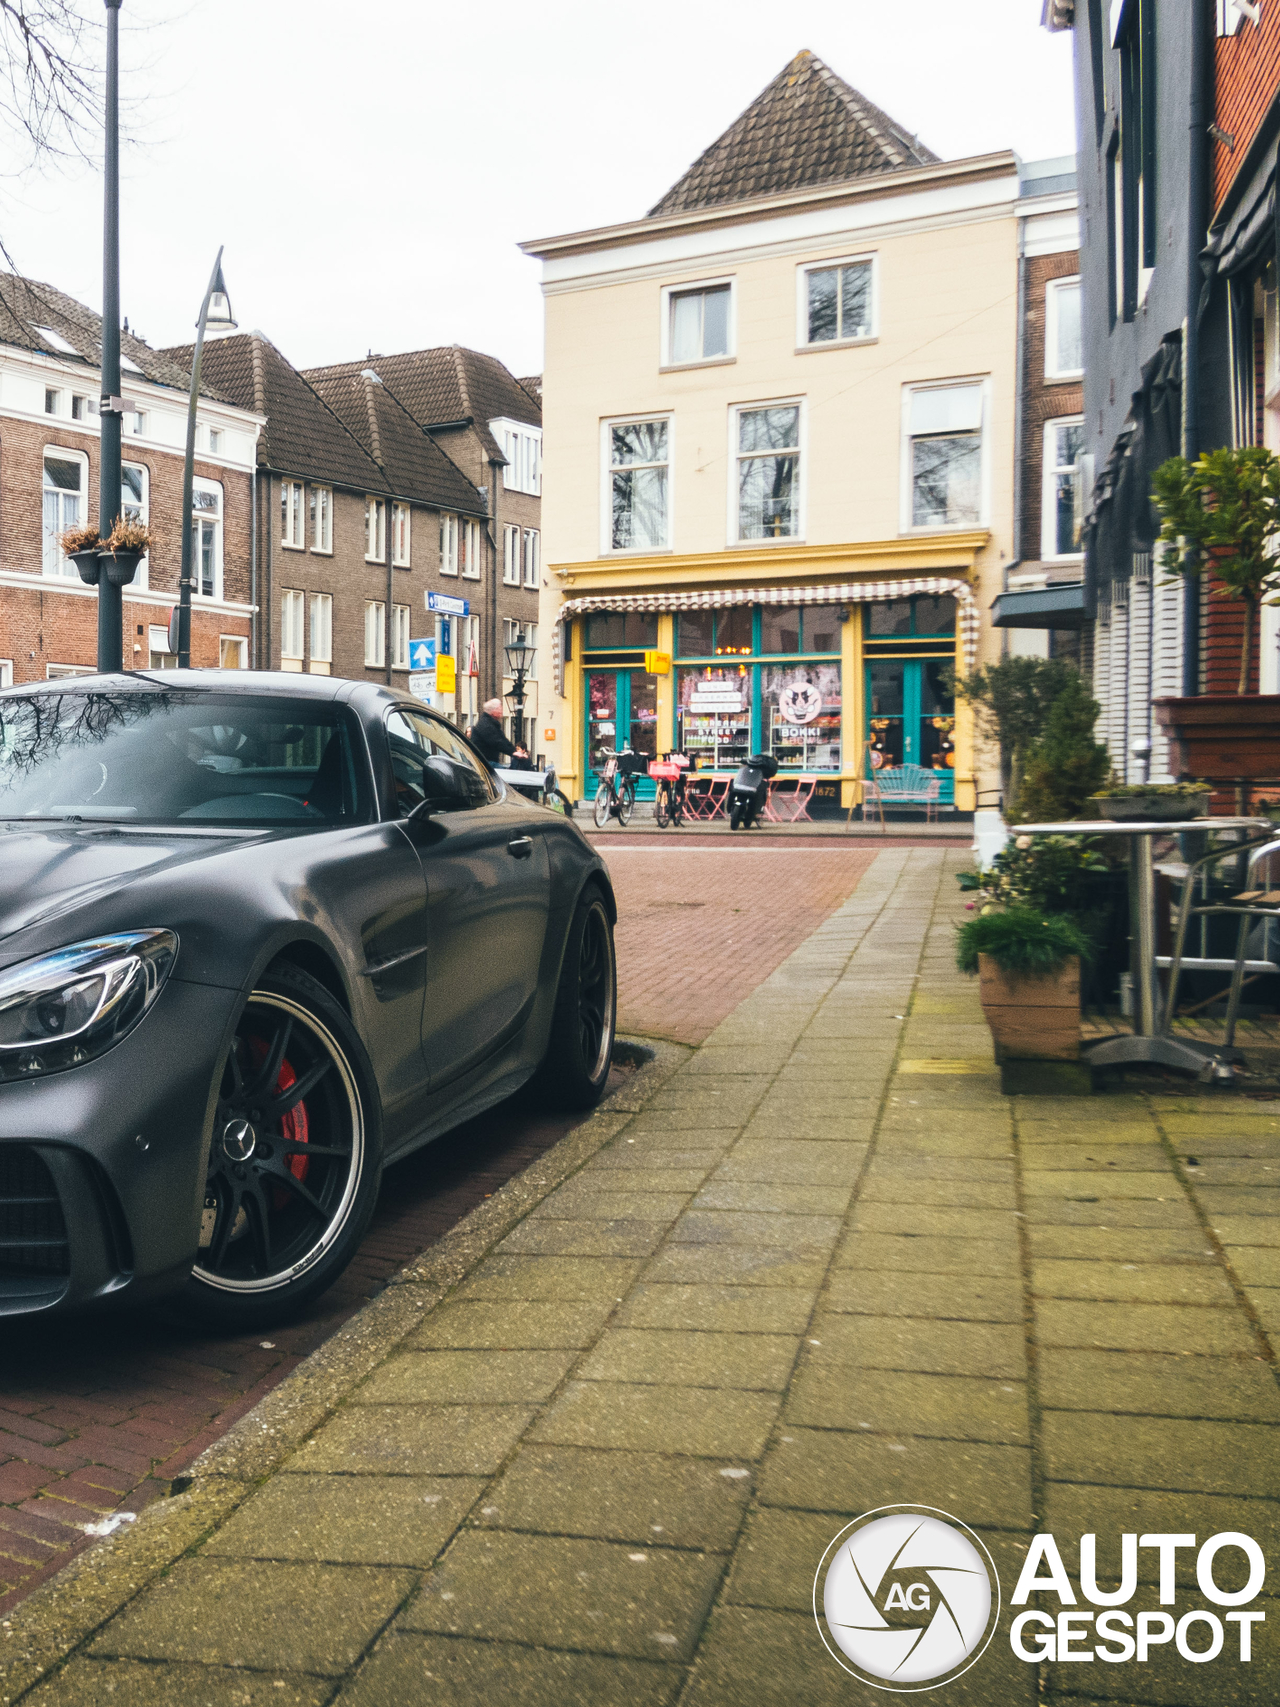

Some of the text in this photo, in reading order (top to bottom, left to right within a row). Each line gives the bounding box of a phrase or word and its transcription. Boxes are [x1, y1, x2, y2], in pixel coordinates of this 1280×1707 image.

[548, 710, 554, 719] 7
[782, 727, 820, 737] BOKKI
[816, 787, 835, 799] 1872
